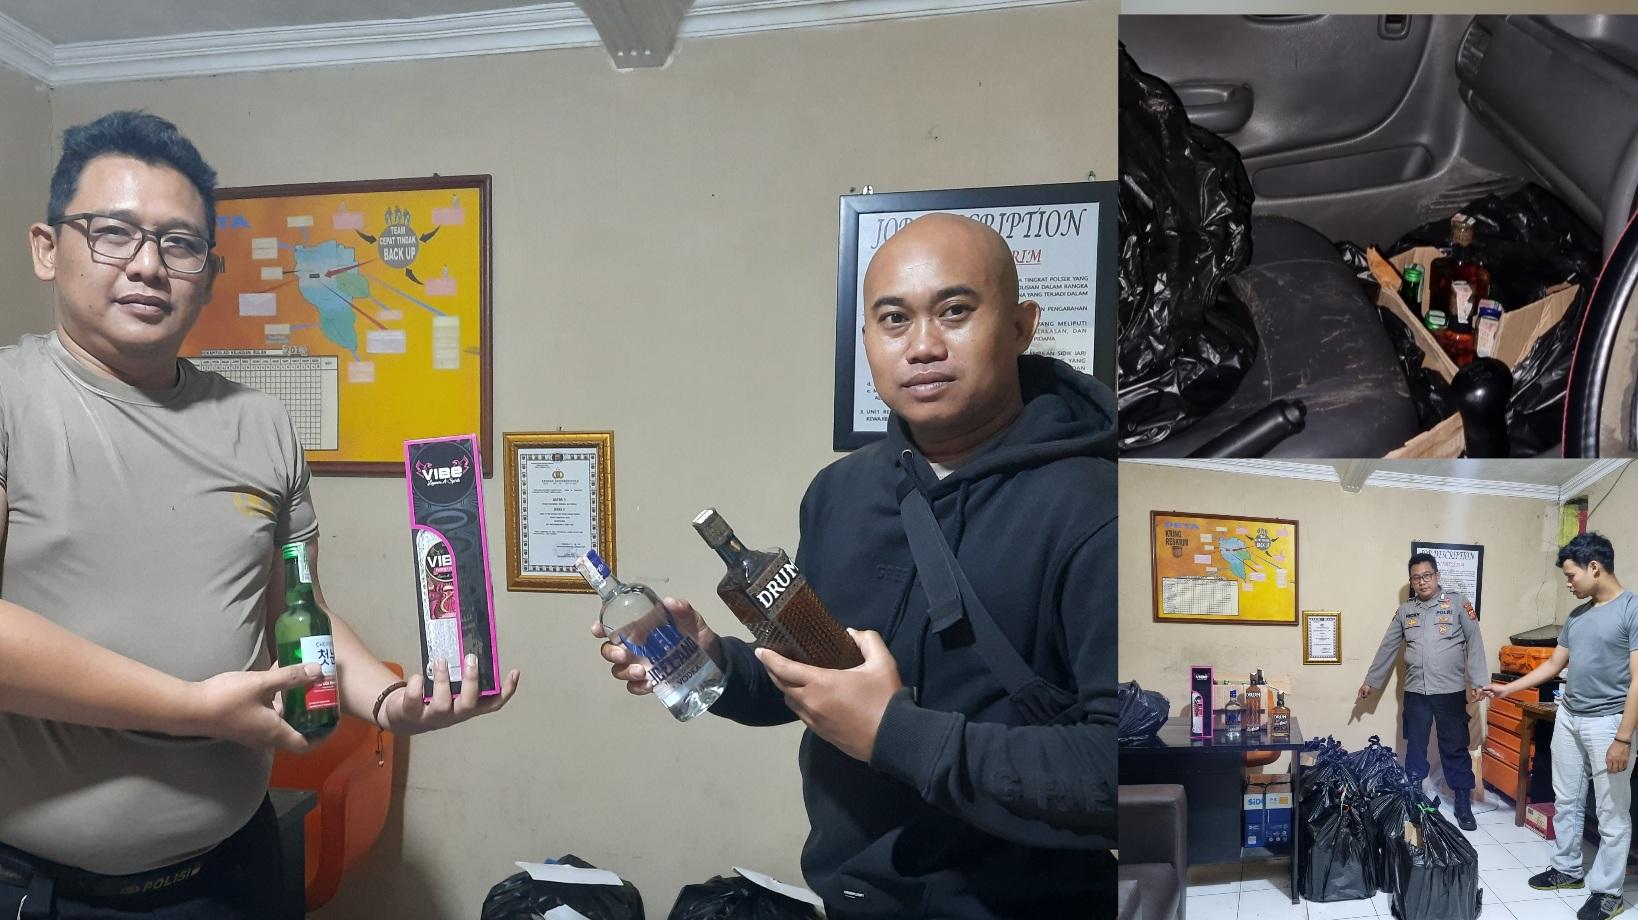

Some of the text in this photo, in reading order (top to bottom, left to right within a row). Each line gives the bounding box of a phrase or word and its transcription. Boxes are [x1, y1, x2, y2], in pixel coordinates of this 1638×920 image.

[390, 226, 406, 235] TEAM
[383, 246, 416, 261] BACK UP
[422, 465, 463, 481] VIBE
[756, 560, 800, 609] DRUM
[678, 664, 702, 686] VODKA
[142, 867, 193, 893] POLISI
